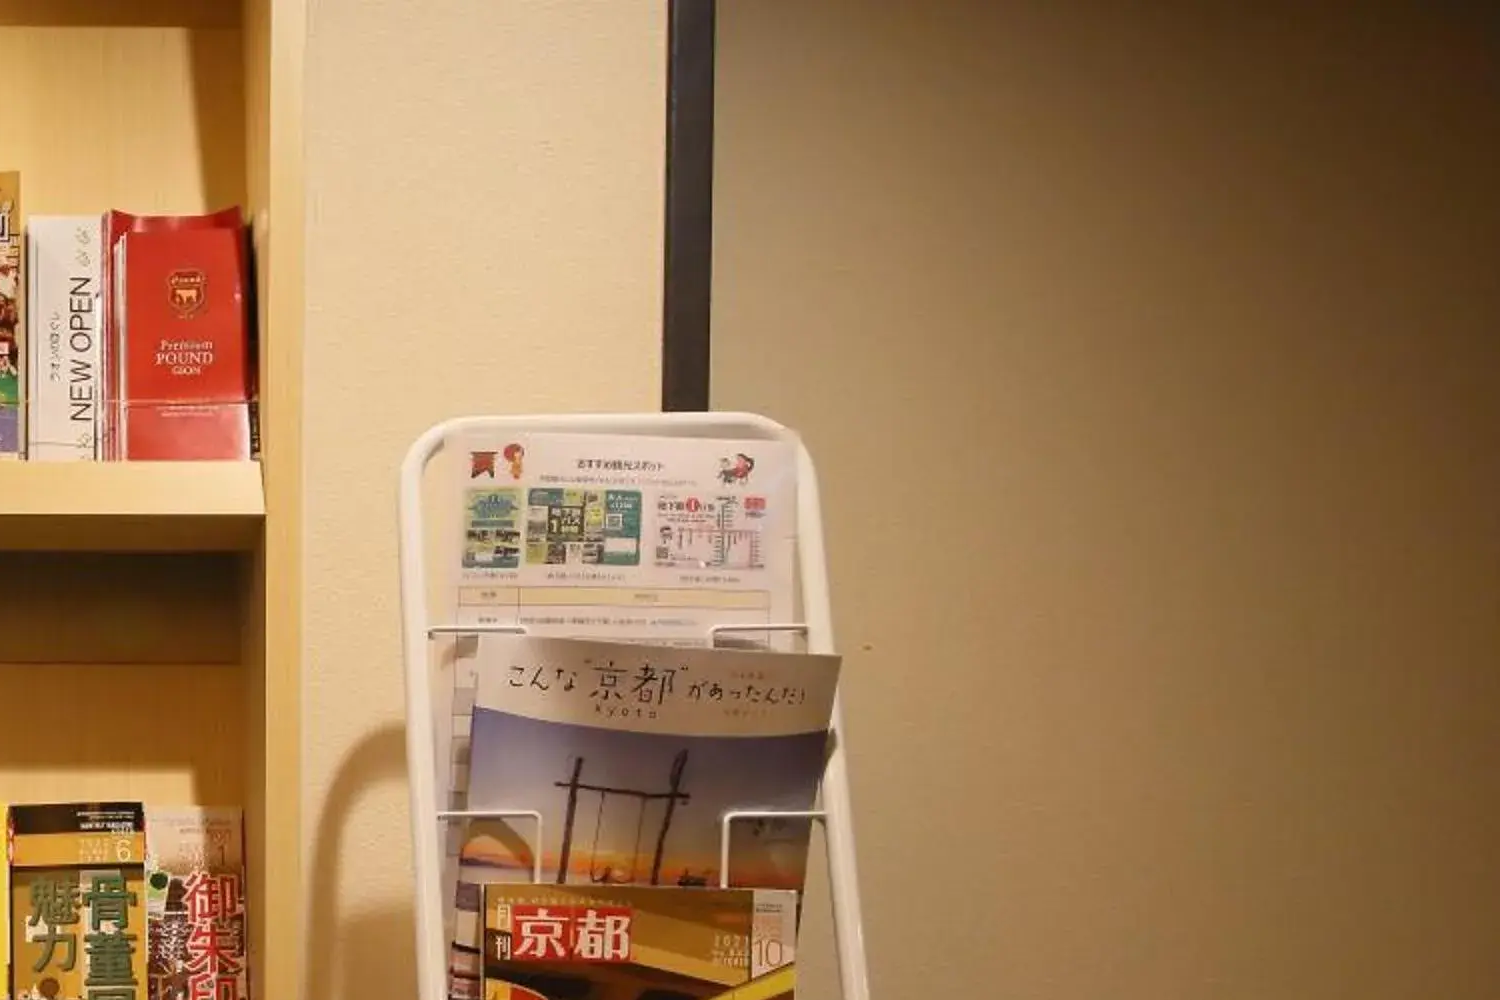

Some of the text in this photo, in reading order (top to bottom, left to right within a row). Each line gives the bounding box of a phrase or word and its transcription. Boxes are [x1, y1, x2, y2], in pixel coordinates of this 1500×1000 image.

[69, 276, 93, 421] NEW OPEN
[160, 339, 213, 351] Premium
[155, 351, 214, 366] POUND
[593, 705, 658, 720] kyoto
[116, 839, 132, 863] 6
[495, 903, 631, 961] 月刊 京都
[753, 937, 784, 968] 10
